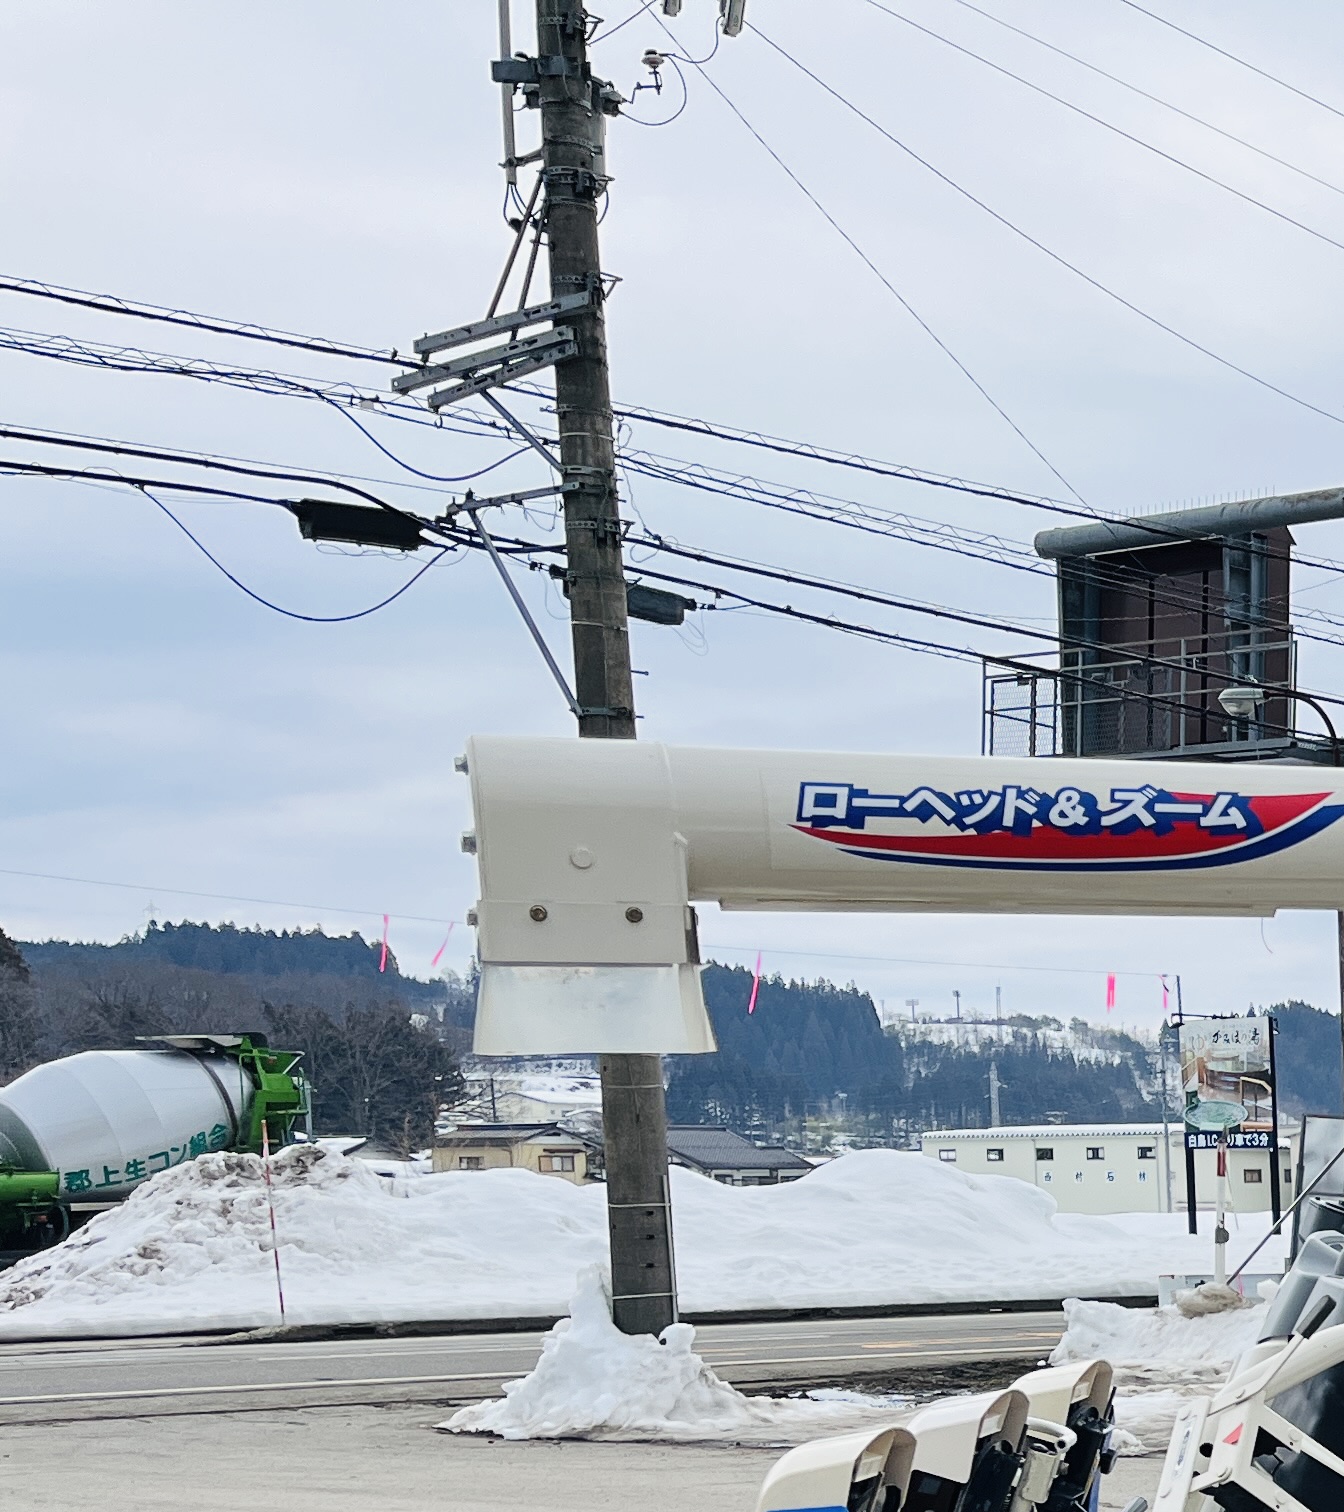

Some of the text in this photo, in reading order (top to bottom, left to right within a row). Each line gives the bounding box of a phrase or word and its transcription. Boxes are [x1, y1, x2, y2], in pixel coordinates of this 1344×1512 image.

[798, 783, 1262, 837] ローヘッド&ズーム
[64, 1123, 228, 1193] 郡上生コン組合
